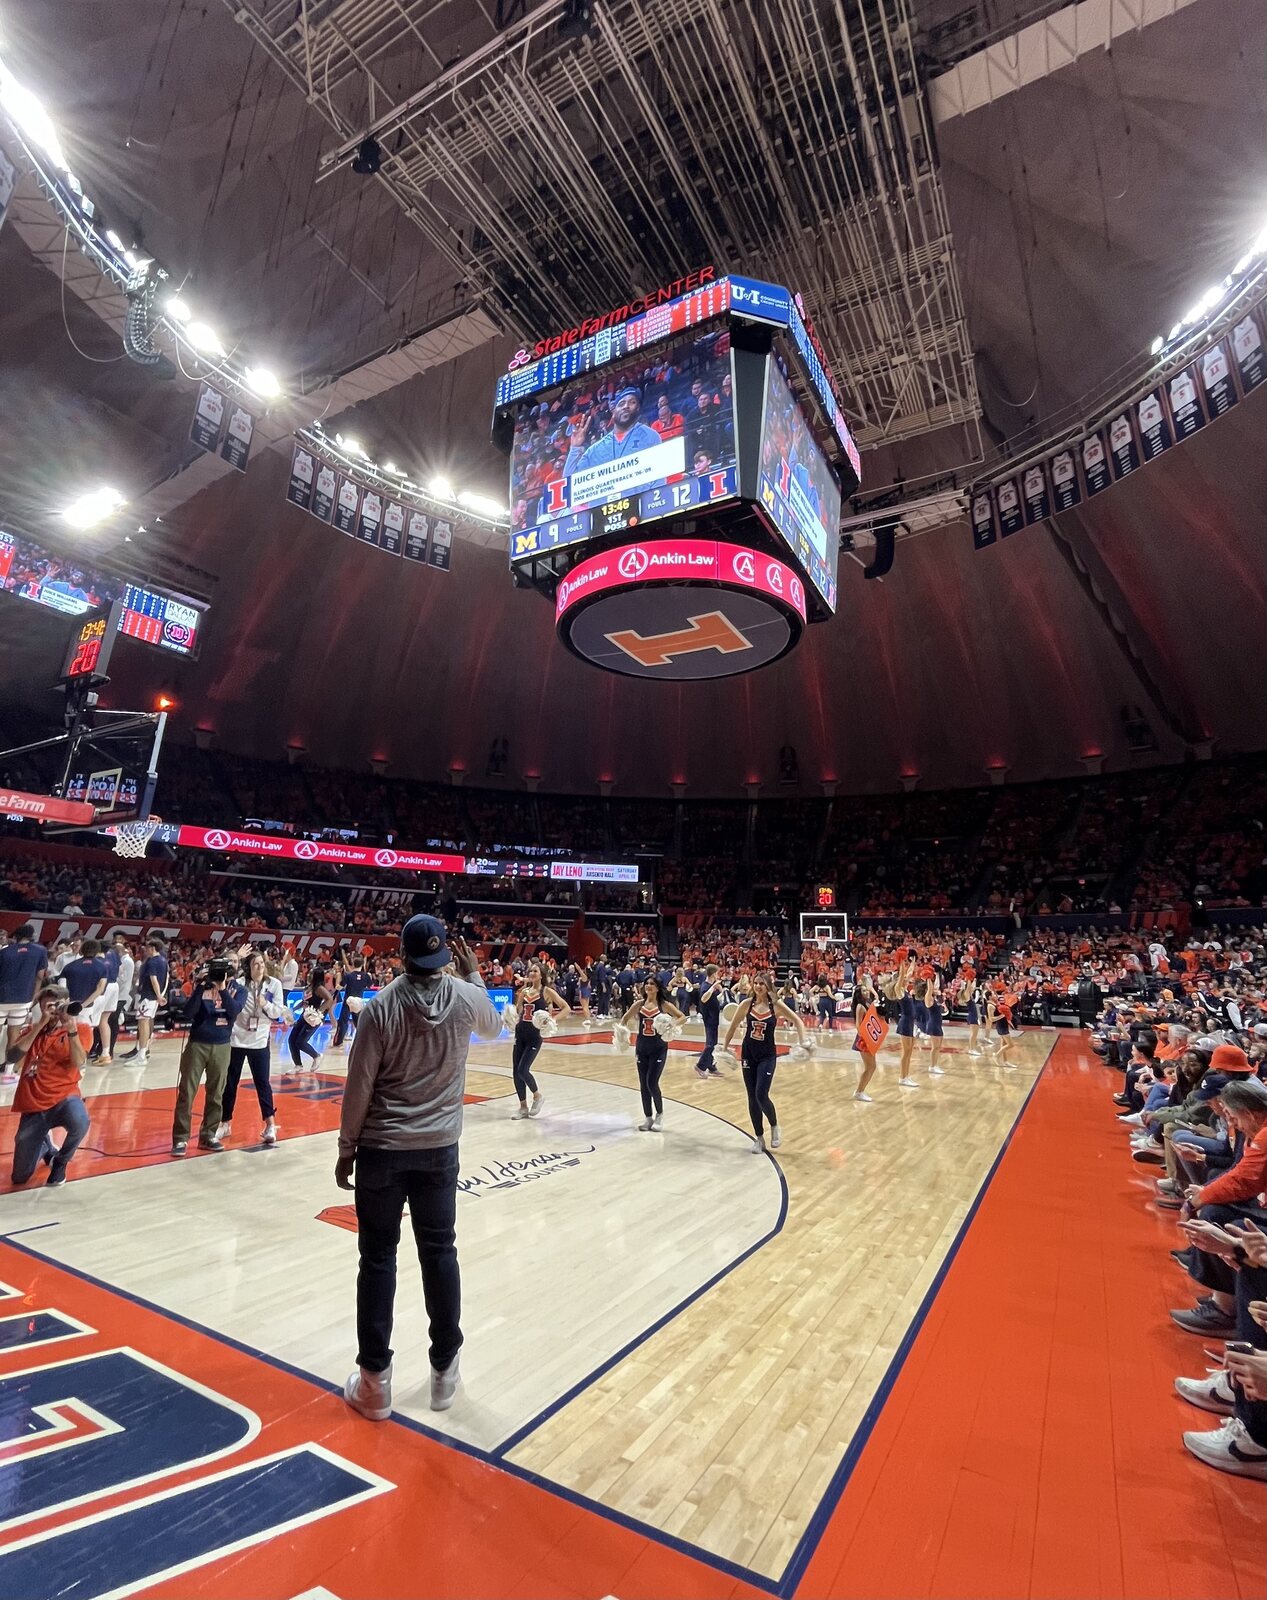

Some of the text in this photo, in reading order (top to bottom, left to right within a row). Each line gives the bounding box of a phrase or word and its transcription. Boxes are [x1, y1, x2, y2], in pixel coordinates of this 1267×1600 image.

[705, 281, 715, 290] AST
[719, 276, 727, 284] FLS
[573, 457, 640, 487] JUICE WILLIAMS
[573, 486, 595, 497] ILLINOIS
[597, 473, 633, 491] QUARTERBACK
[710, 472, 728, 499] I
[573, 486, 614, 504] 2008 ROSE BOWL
[653, 490, 661, 502] 2
[672, 484, 691, 508] 12
[601, 499, 630, 516] 13:46
[647, 500, 666, 510] FOULS
[572, 514, 578, 524] 1
[604, 521, 627, 533] POSS
[607, 513, 622, 524] 1ST
[549, 524, 559, 543] 9
[566, 524, 583, 534] FOULS
[515, 531, 538, 554] M
[650, 553, 686, 565] Ankin
[688, 553, 714, 565] Law
[589, 565, 608, 582] Law
[169, 602, 196, 619] RYAN
[69, 639, 101, 676] 20
[162, 831, 170, 842] 4
[231, 837, 260, 850] Ankin
[262, 839, 283, 851] Law
[319, 846, 345, 858] Ankin
[347, 850, 366, 860] Law
[398, 855, 421, 864] Ankin
[424, 858, 442, 866] Law
[553, 865, 582, 877] JAY LENO
[819, 894, 832, 905] 20
[495, 996, 509, 1004] IHOP
[750, 1020, 768, 1042] I
[866, 1015, 883, 1042] GO
[481, 1144, 596, 1182] Henson
[514, 1164, 567, 1184] COURT
